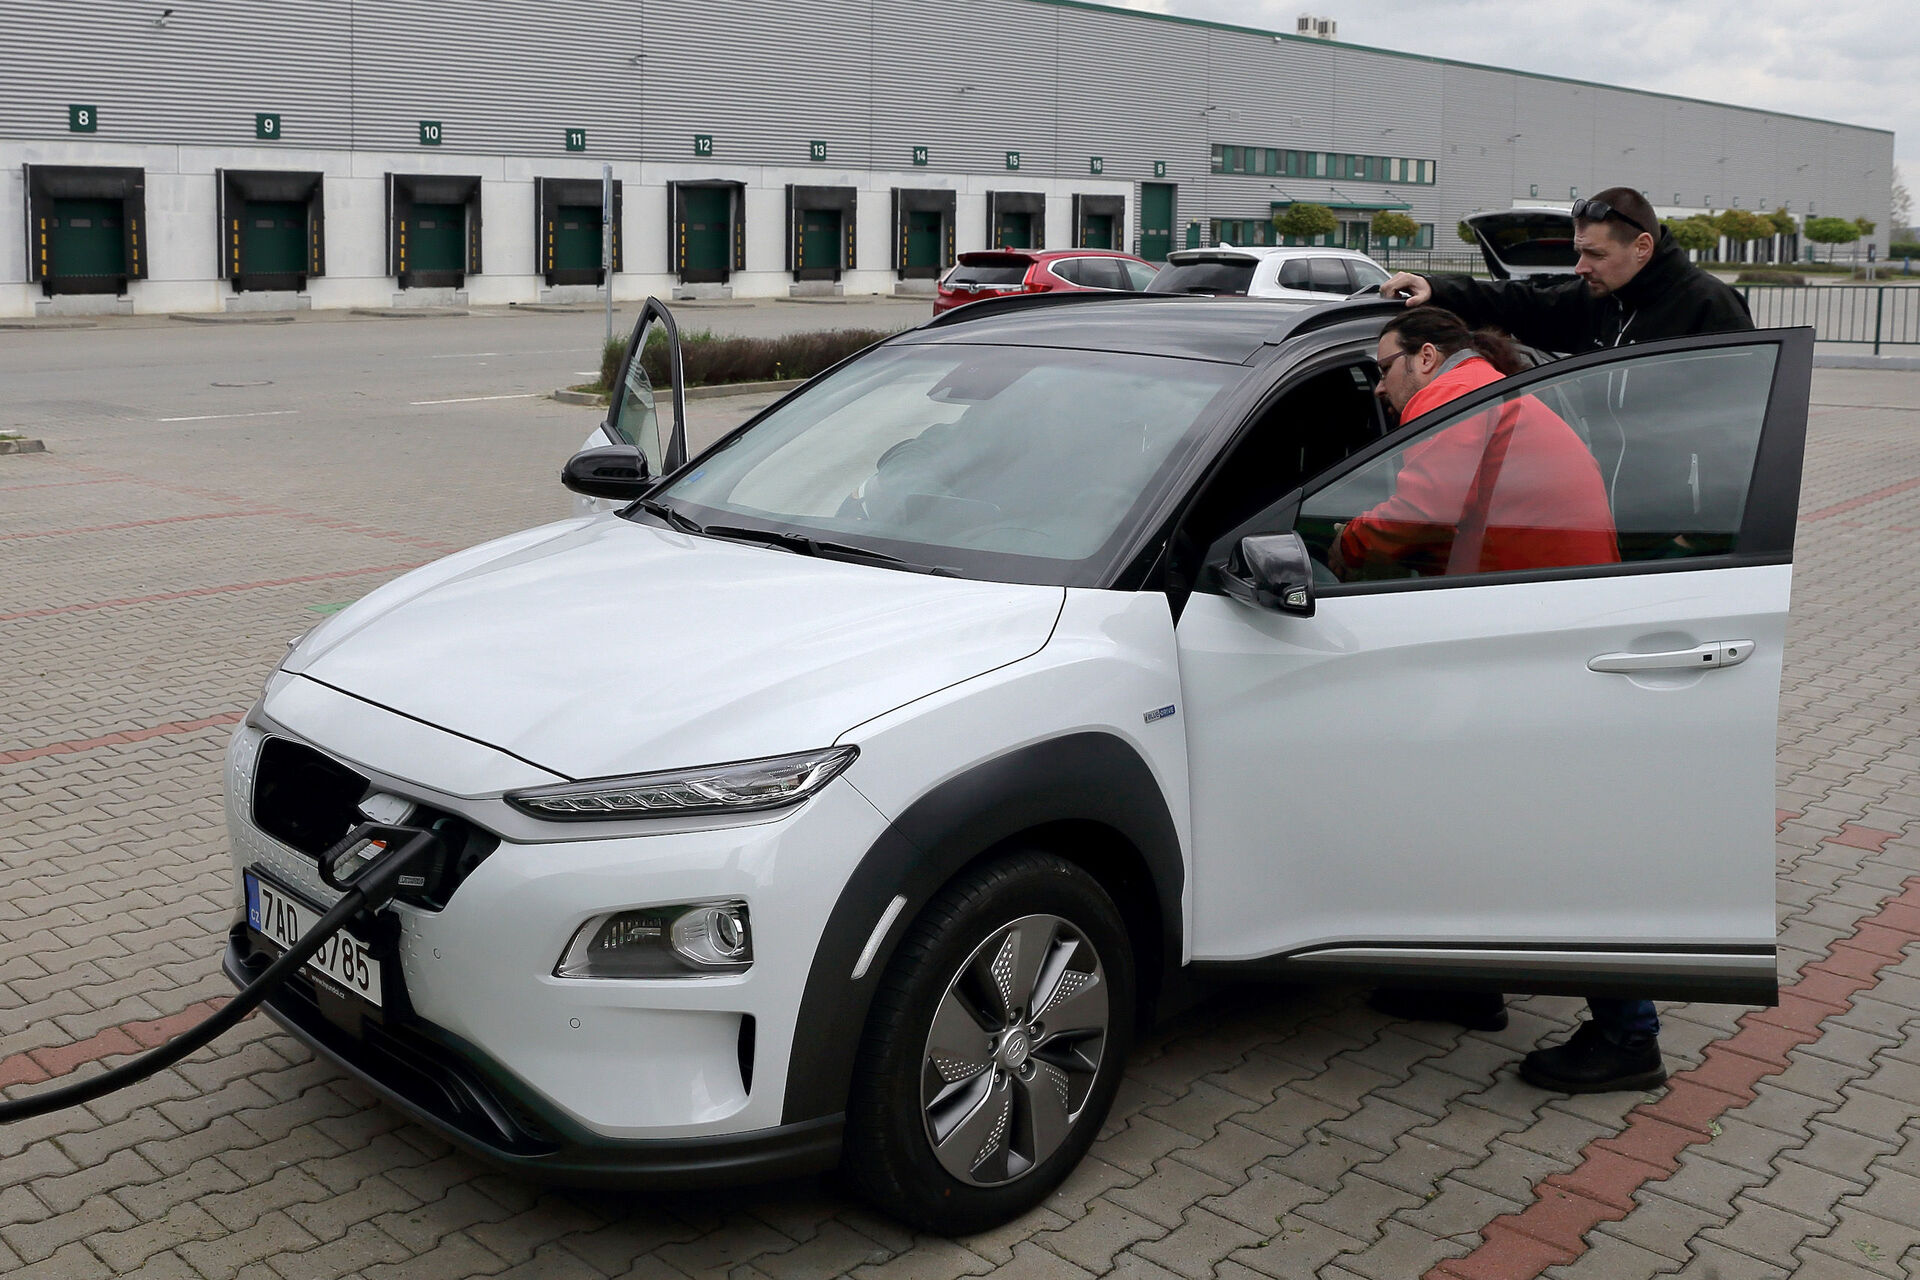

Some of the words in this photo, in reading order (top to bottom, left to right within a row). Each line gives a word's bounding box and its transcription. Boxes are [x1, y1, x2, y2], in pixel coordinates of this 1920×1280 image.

[78, 110, 89, 125] 8
[264, 119, 274, 133] 9
[424, 126, 438, 140] 10
[571, 133, 582, 146] 11
[698, 139, 710, 151] 12
[813, 145, 825, 157] 13
[916, 150, 926, 161] 14
[1009, 155, 1018, 166] 15
[1093, 160, 1102, 170] 16
[250, 908, 260, 923] CZ
[263, 889, 298, 946] 7AD
